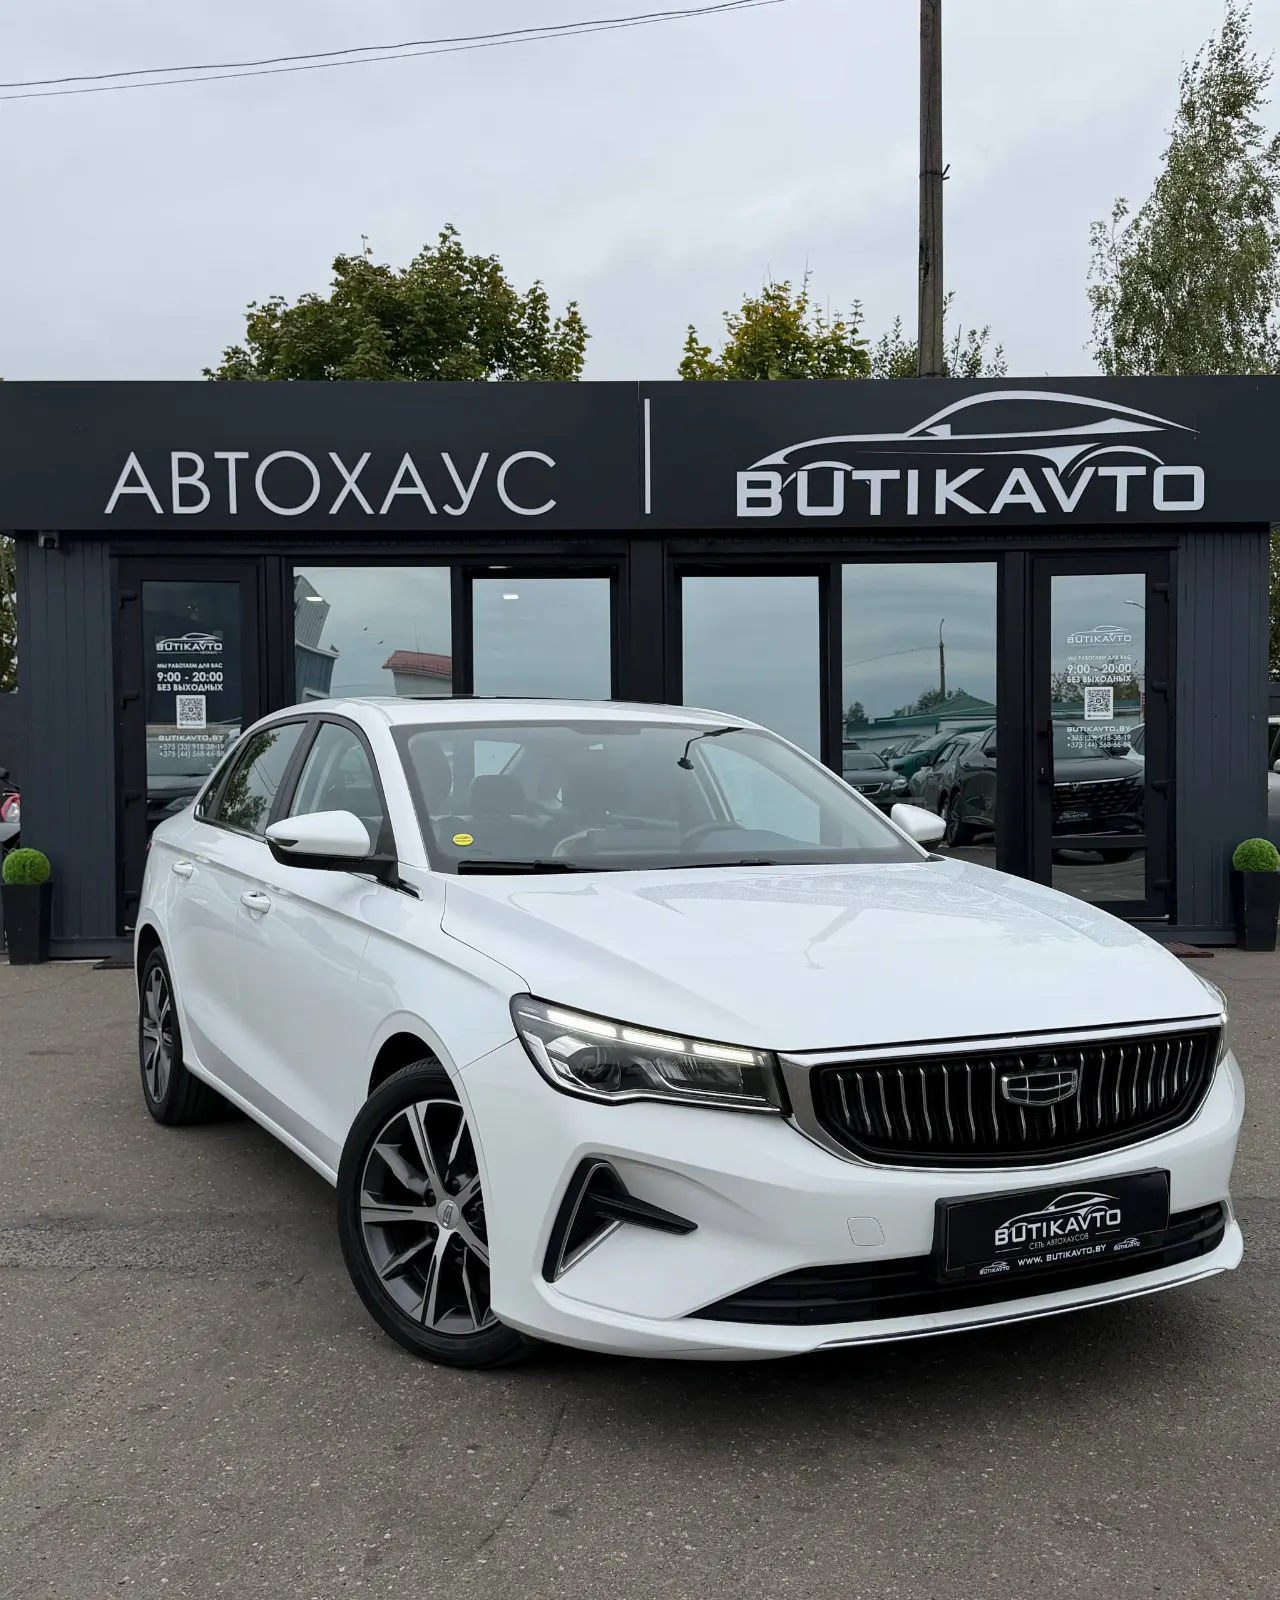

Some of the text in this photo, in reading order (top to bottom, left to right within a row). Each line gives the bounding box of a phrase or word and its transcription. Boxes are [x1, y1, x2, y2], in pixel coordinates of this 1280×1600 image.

[104, 450, 557, 516] АВТОХАУС
[737, 464, 1205, 517] BUTIKAVTO
[1067, 635, 1132, 643] BUTIKAVTO
[156, 642, 223, 651] BUTIKAVTO
[1067, 664, 1090, 674] 9:00
[1101, 663, 1132, 673] 20:00
[157, 672, 181, 682] 9:00
[192, 671, 223, 682] 20:00
[1082, 675, 1132, 683] ВЫХОДНЫХ
[157, 683, 223, 692] БЕЗ ВЫХОДНЫХ
[994, 1209, 1121, 1246] BUTIKAVTO
[1029, 1233, 1089, 1250] СЕТЬ АВТОХАУСОВ
[1017, 1244, 1107, 1266] WWW. BUTIKAVTO.BY
[979, 1265, 1010, 1275] BUTIKAVTO
